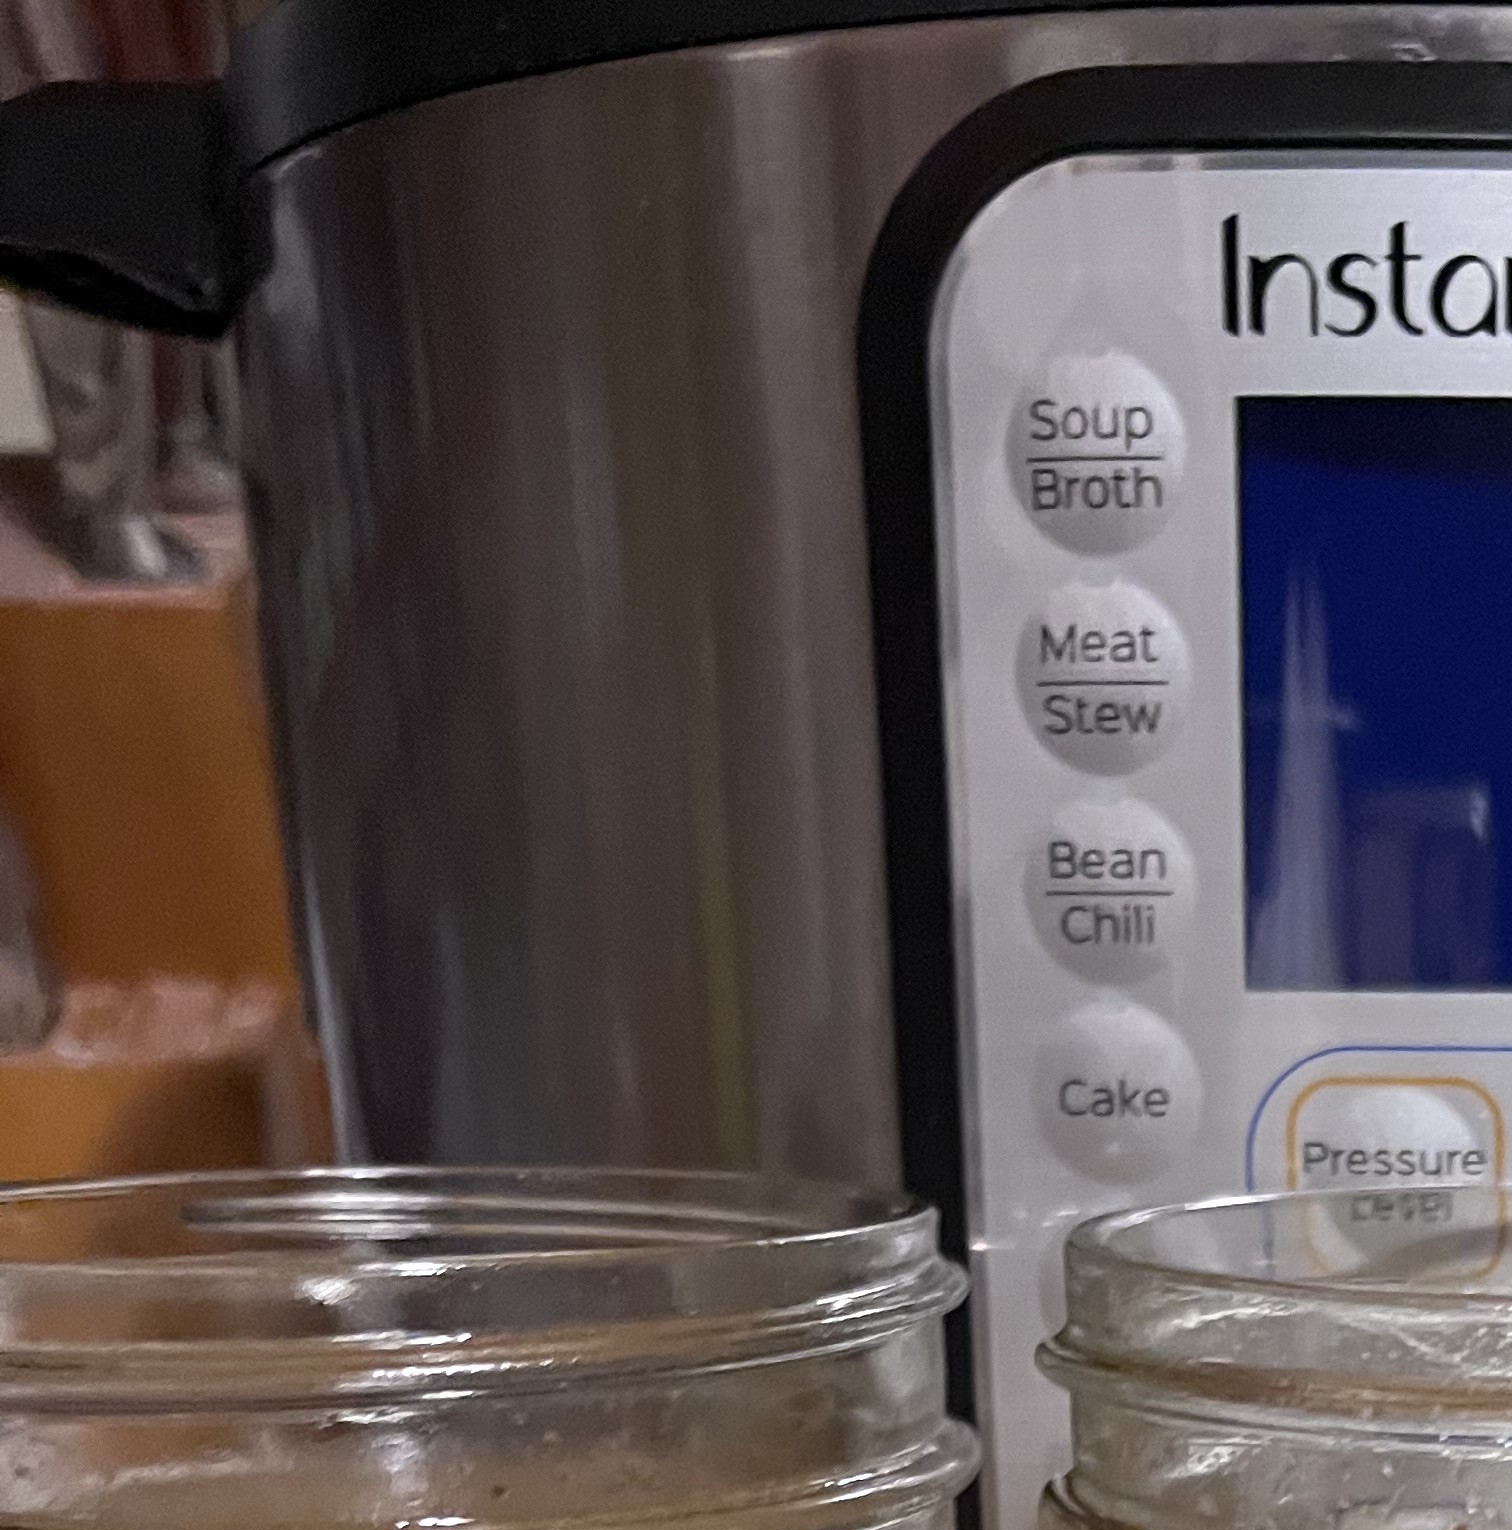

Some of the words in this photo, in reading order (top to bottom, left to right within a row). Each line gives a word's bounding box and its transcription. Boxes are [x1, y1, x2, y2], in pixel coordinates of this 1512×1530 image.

[1030, 399, 1154, 450] Soup
[1032, 467, 1163, 511] Broth
[1038, 623, 1160, 664] Meat
[1043, 694, 1163, 734] Stew
[1049, 840, 1167, 880] Bean
[1061, 904, 1156, 944] Chili
[1058, 1078, 1170, 1117] Cake
[1302, 1141, 1488, 1177] Pressure
